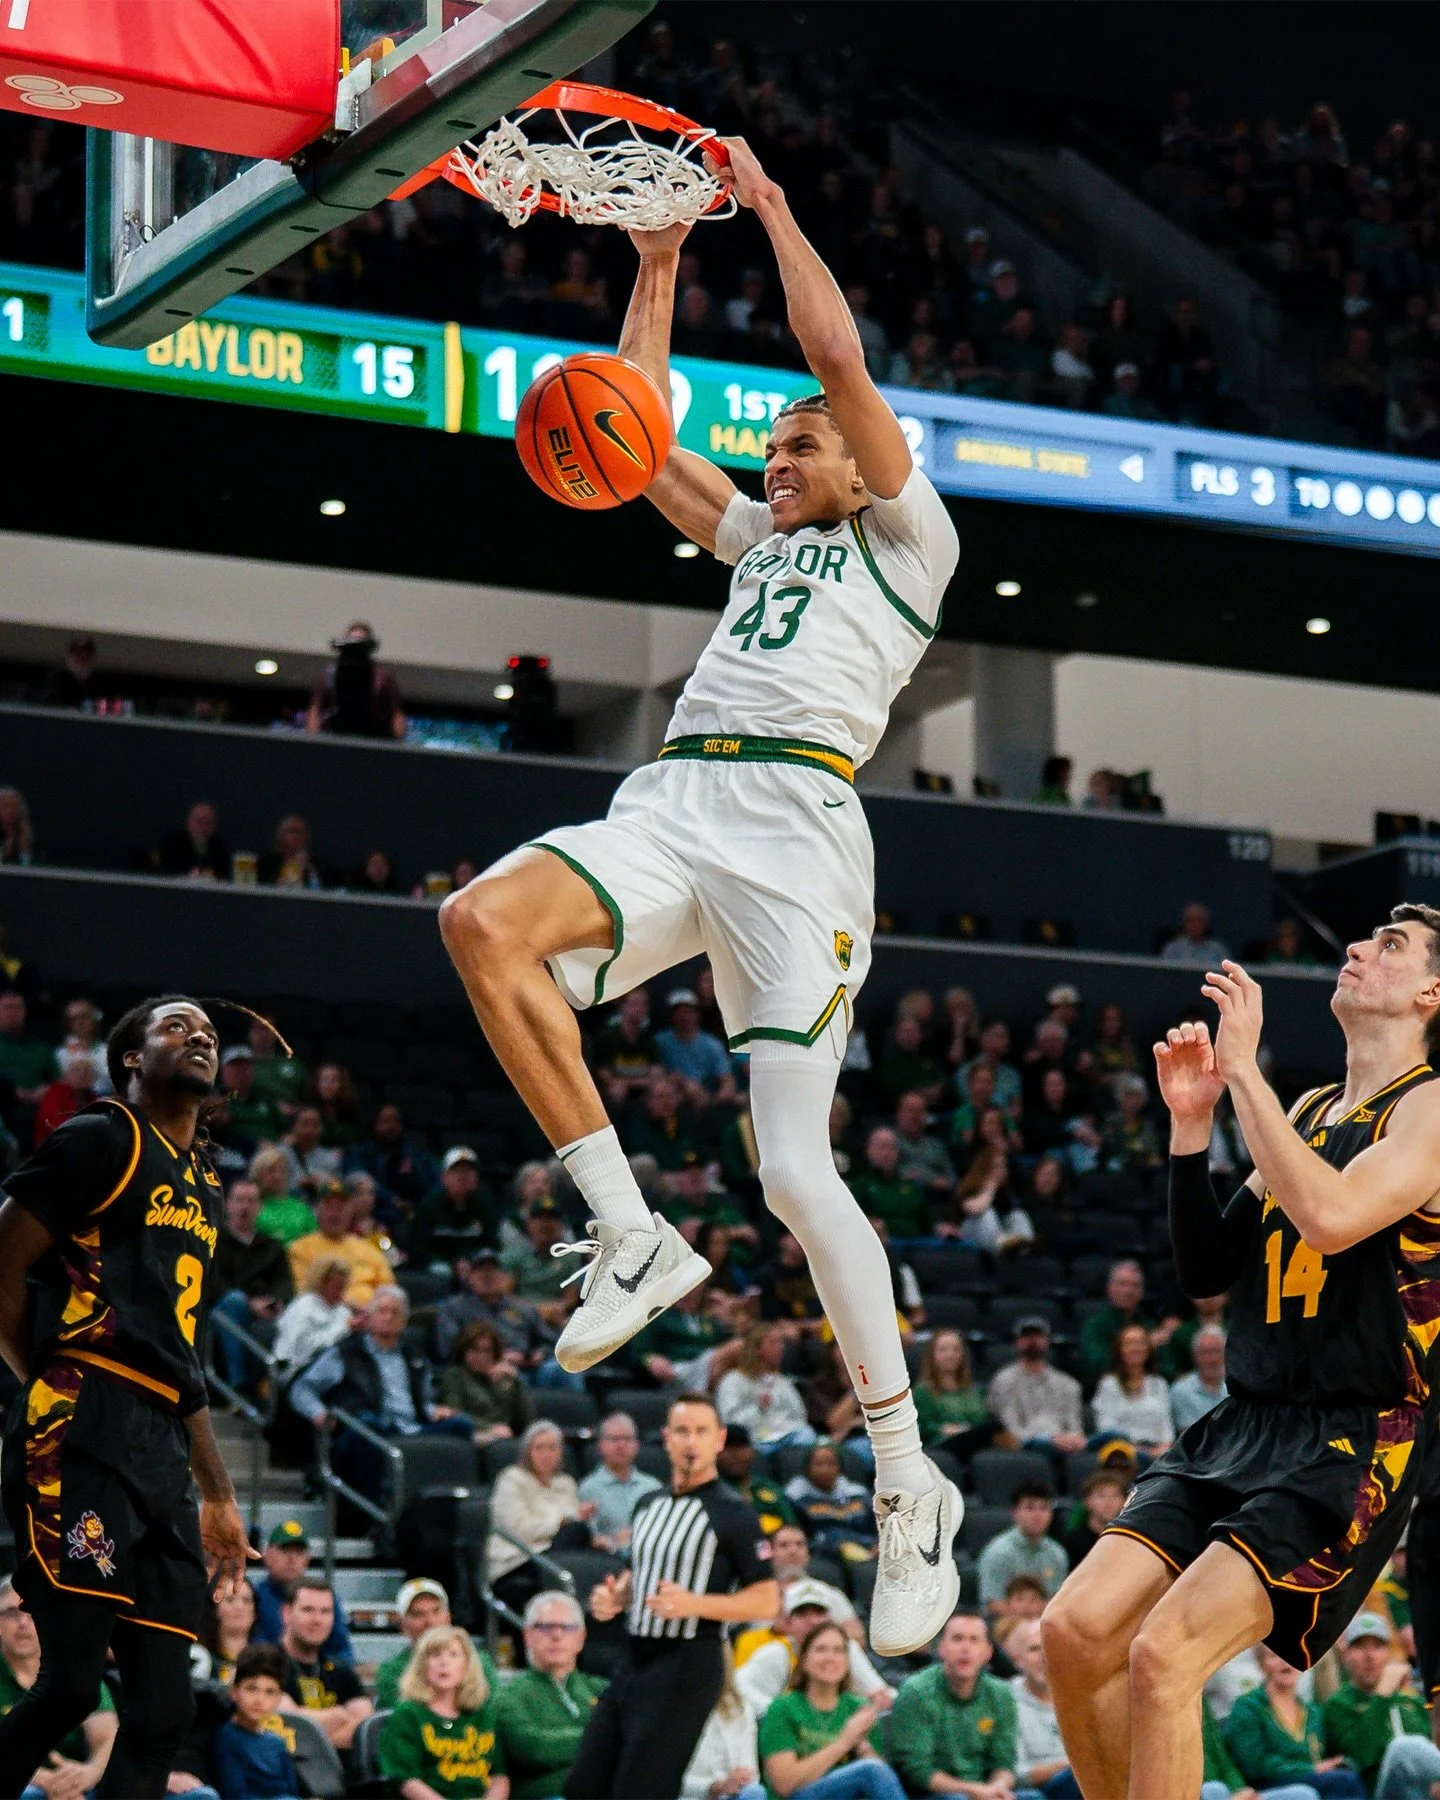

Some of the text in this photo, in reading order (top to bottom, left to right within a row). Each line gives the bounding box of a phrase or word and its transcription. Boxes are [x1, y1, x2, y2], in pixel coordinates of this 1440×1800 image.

[352, 342, 414, 399] 15
[724, 383, 788, 422] 1ST
[548, 426, 599, 499] ELITE
[709, 423, 768, 459] HAL
[1191, 462, 1276, 506] FLS 3
[730, 581, 812, 652] 43
[175, 1253, 203, 1347] 2
[1265, 1230, 1328, 1324] 14
